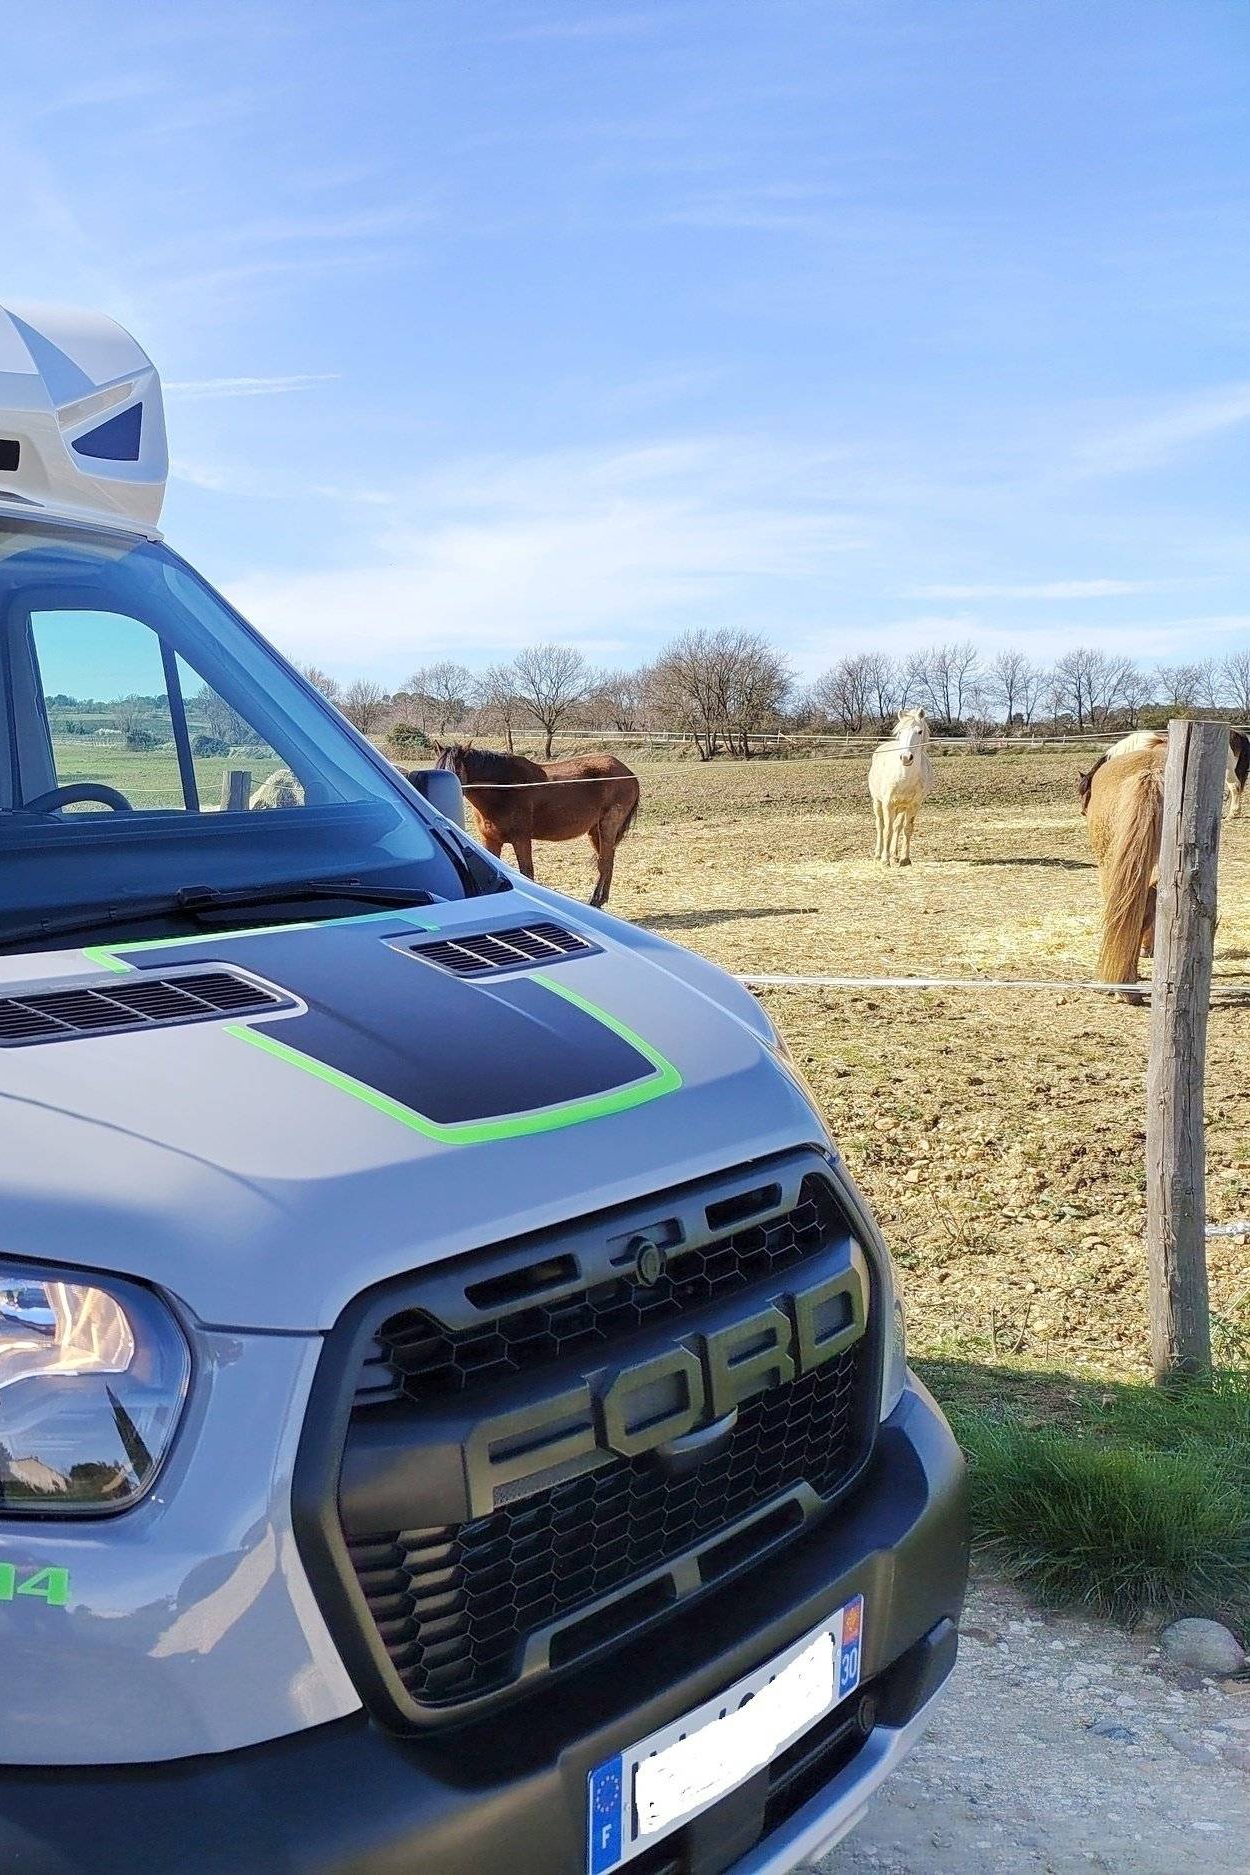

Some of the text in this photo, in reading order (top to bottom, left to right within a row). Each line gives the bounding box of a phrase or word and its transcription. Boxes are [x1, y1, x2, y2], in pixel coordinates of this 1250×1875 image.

[462, 1255, 871, 1520] FORD
[840, 1647, 858, 1687] 30
[601, 1823, 613, 1850] F
